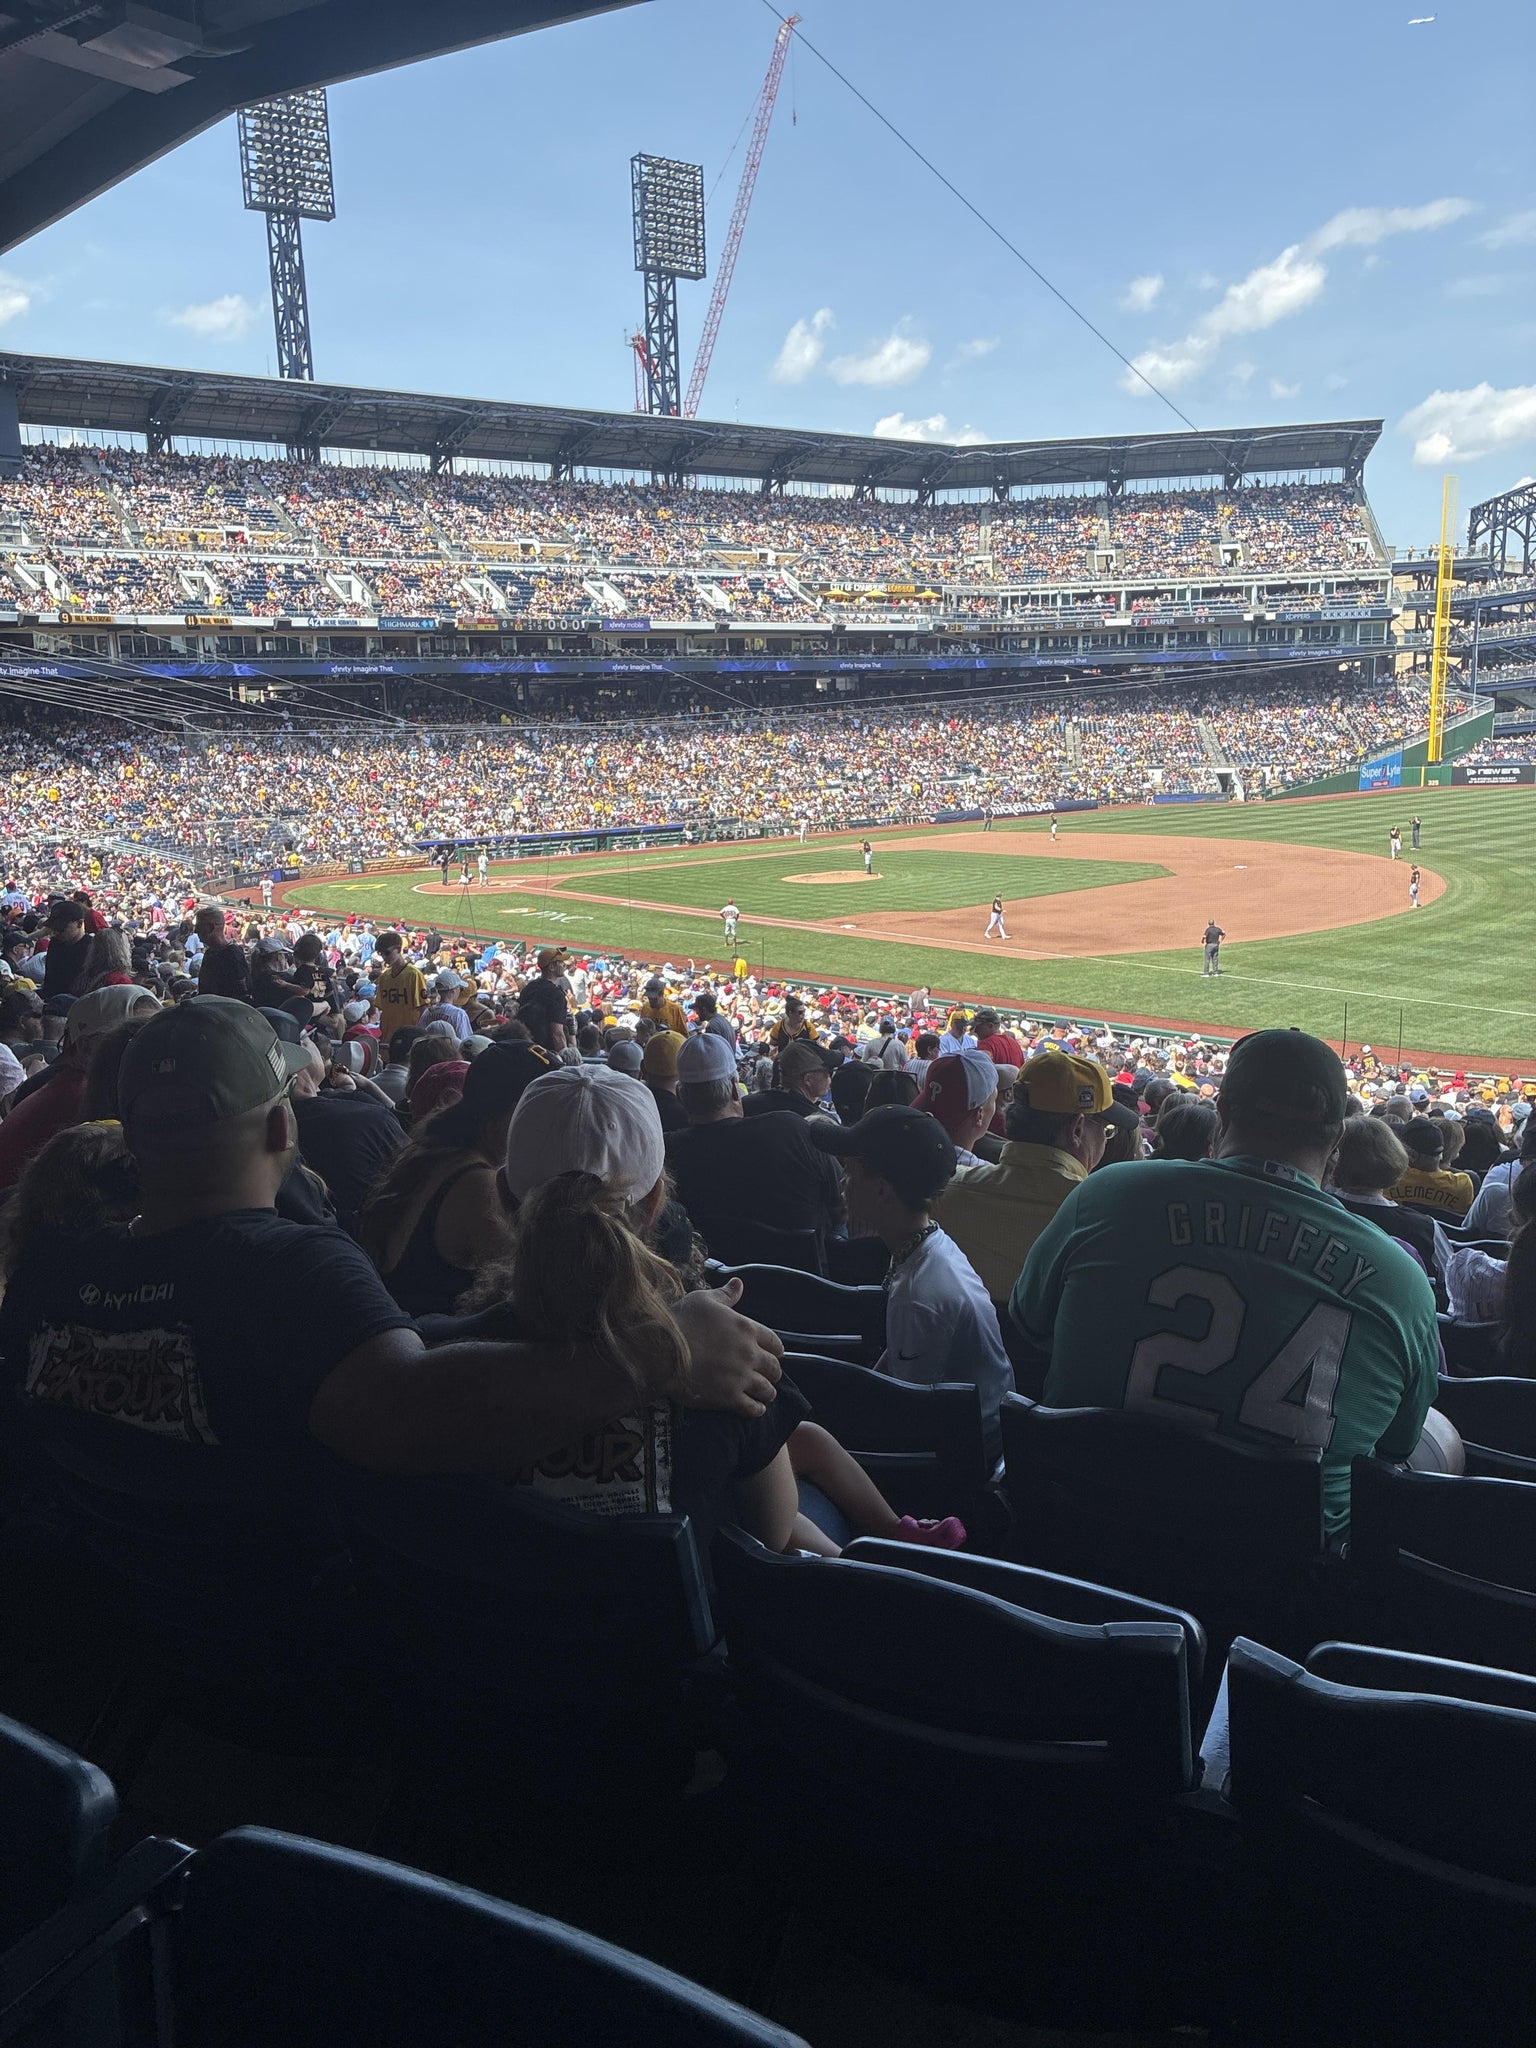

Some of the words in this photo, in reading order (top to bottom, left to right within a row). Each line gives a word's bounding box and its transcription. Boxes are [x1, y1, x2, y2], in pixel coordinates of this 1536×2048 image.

[308, 617, 320, 627] 42
[385, 620, 420, 628] HIGHMARK
[609, 621, 626, 629] xfinity
[1289, 649, 1307, 657] xfinity
[1307, 649, 1330, 657] Imagine
[9, 667, 40, 676] Imagine
[41, 667, 58, 675] That
[330, 665, 352, 673] xfinity
[353, 665, 378, 673] Imagine
[1361, 766, 1382, 780] Super
[1386, 765, 1400, 778] Lyte
[1389, 1185, 1458, 1209] CLEMENTE
[1166, 1200, 1376, 1300] GRIFFEY
[1123, 1263, 1353, 1449] 24
[519, 1431, 644, 1484] OUR
